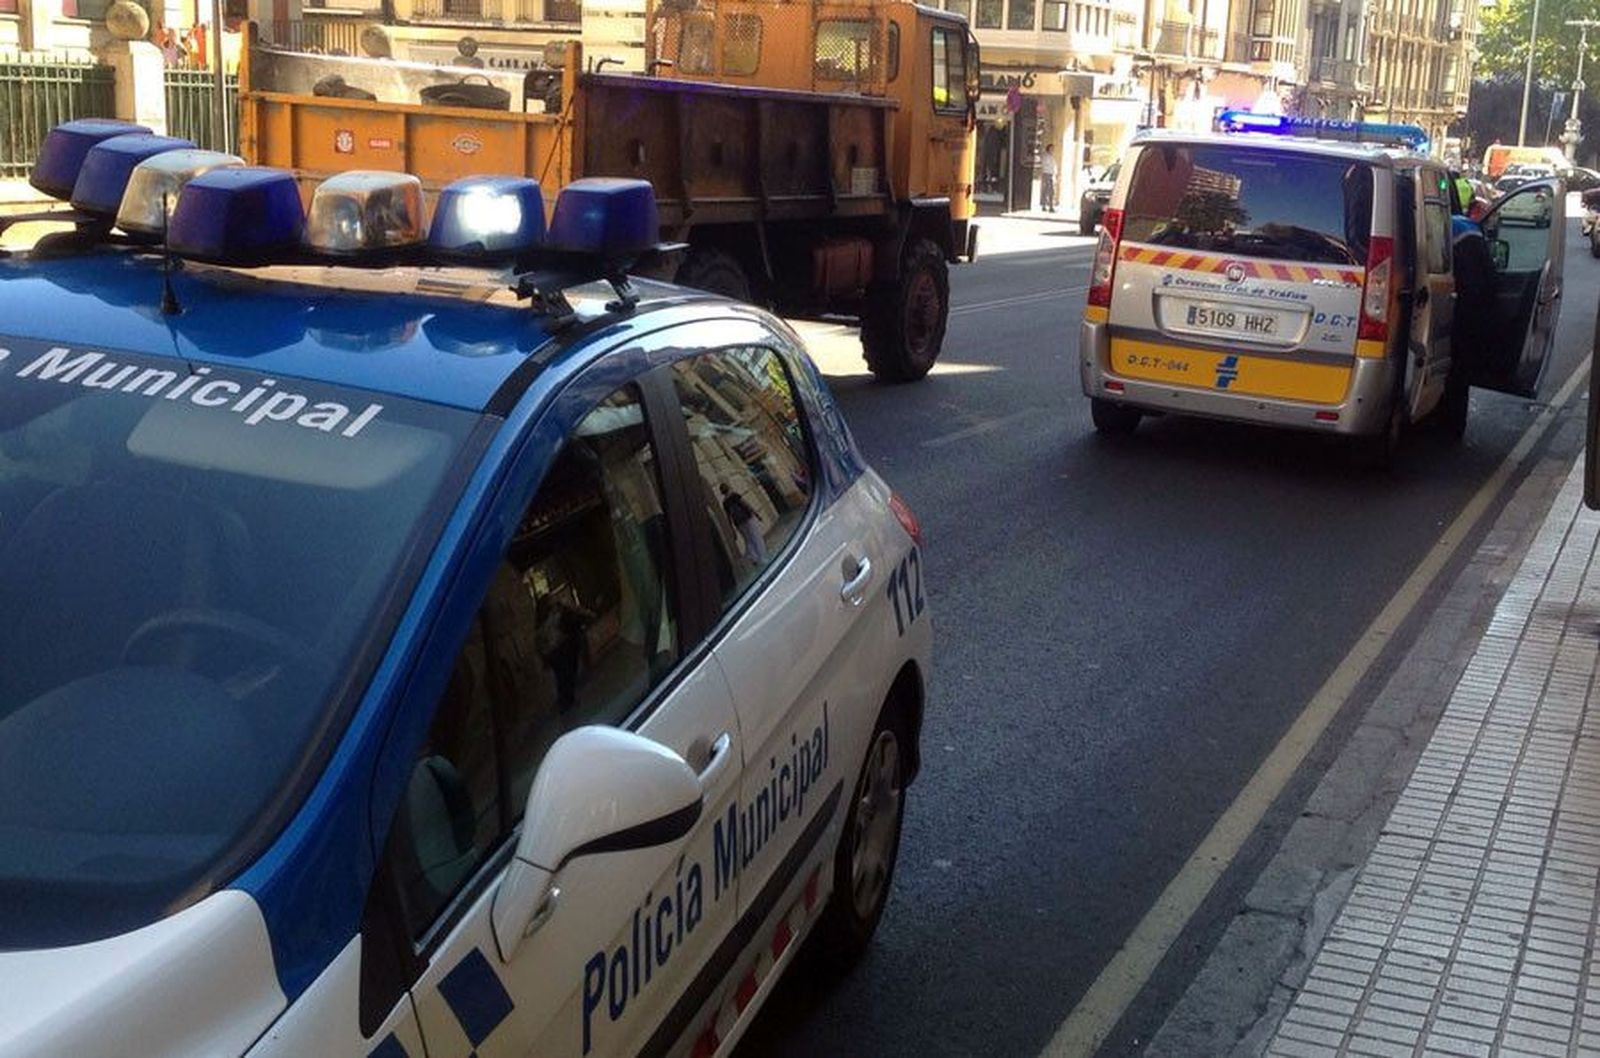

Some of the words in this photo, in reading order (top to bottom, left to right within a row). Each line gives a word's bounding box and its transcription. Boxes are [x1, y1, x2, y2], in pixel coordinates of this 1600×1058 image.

[1198, 306, 1236, 328] 5109
[1244, 314, 1275, 333] HHZ
[15, 346, 385, 438] Municipal
[886, 545, 926, 639] 112
[581, 850, 704, 1056] Policía
[712, 699, 830, 903] Municipal
